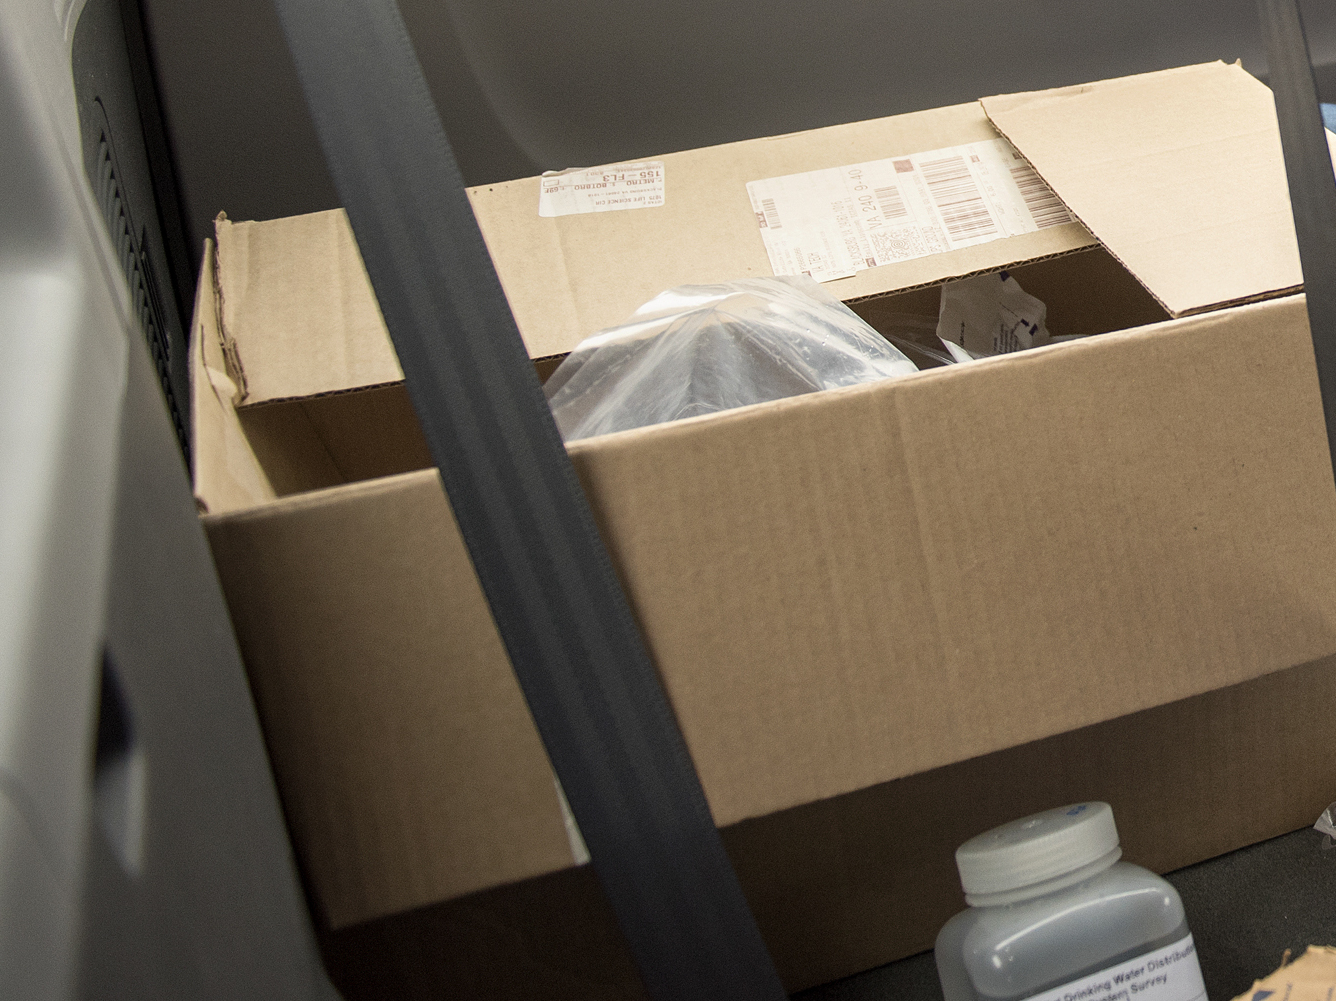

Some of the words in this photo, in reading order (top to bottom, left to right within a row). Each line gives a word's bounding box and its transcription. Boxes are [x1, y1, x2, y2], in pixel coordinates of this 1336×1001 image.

[626, 178, 655, 186] METRO
[848, 168, 868, 191] 9-40
[858, 194, 877, 213] 240
[866, 214, 883, 229] VA
[1112, 966, 1145, 985] Water
[1130, 973, 1168, 994] Survey
